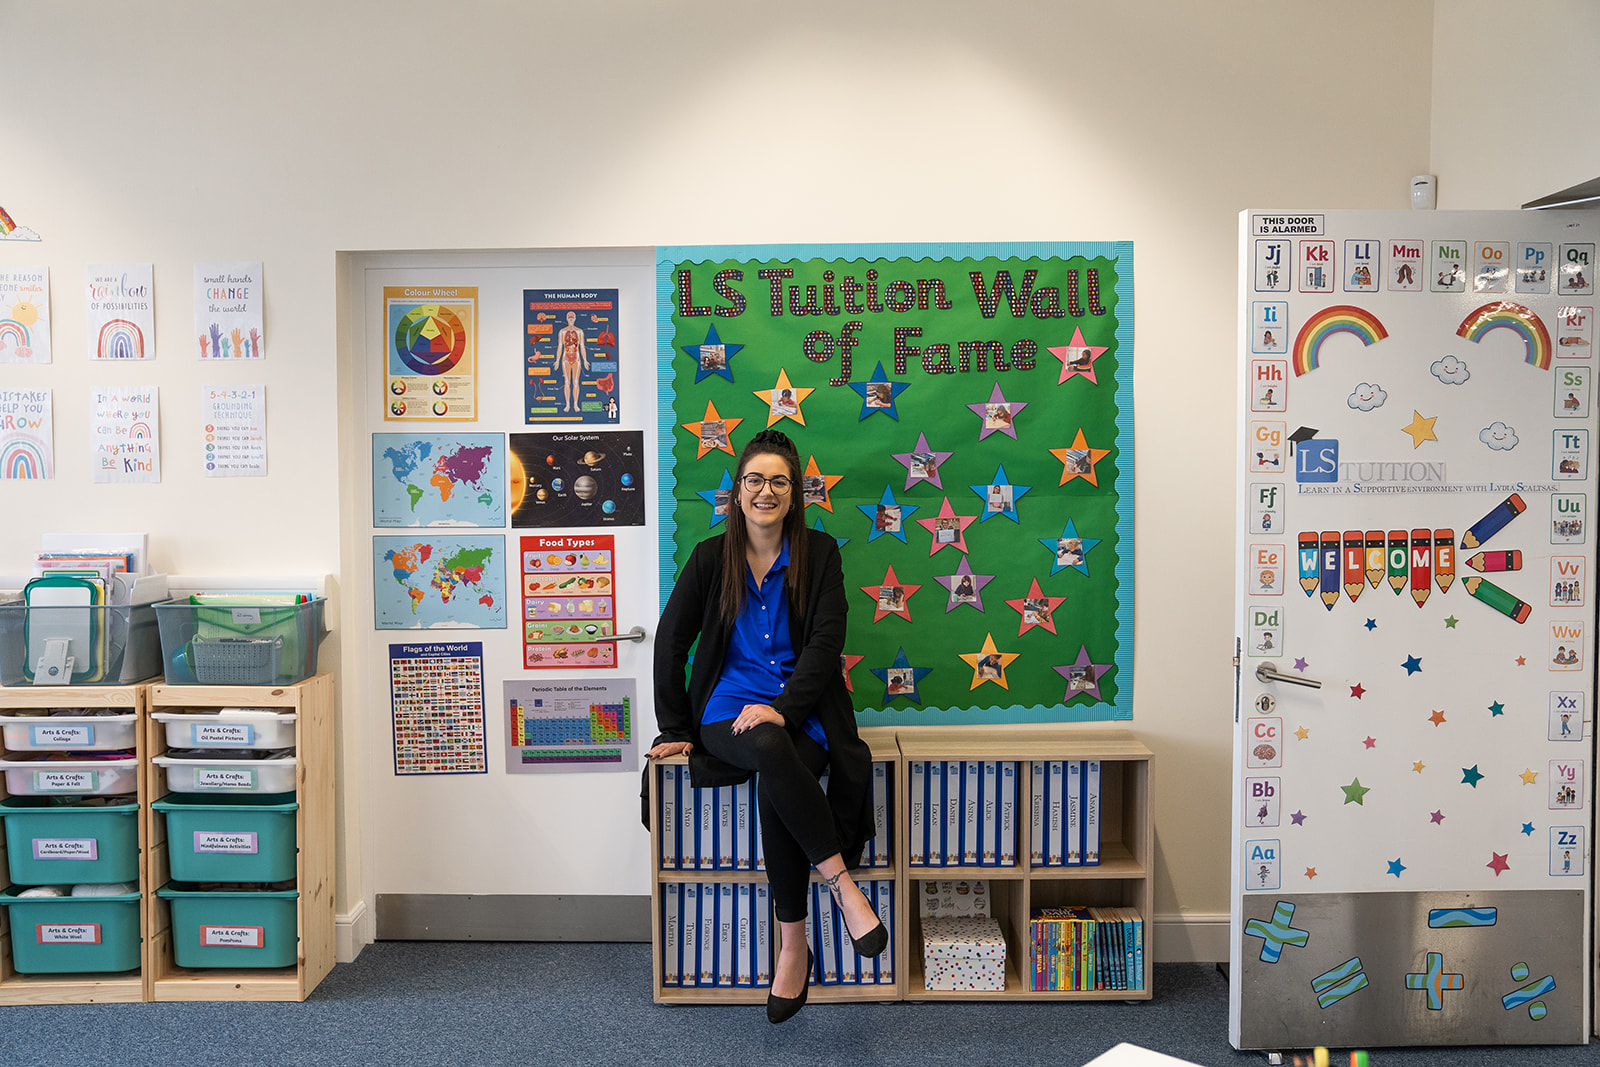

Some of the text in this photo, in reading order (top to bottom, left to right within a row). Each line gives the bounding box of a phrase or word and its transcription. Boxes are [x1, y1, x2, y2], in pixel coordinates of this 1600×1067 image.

[1272, 226, 1318, 234] ALARMED
[1265, 244, 1281, 266] Jj
[1306, 245, 1329, 262] Kk
[1393, 244, 1420, 258] Mm
[1438, 246, 1460, 259] Nn
[1525, 248, 1545, 264] Pp
[1566, 248, 1589, 266] Qq
[90, 272, 148, 300] rainbow
[204, 274, 252, 283] small hands
[206, 288, 248, 300] CHANGE
[678, 268, 1106, 319] LS Tuition Wall
[90, 302, 148, 310] OF POSSIBILITIES
[208, 304, 248, 312] the world
[1264, 306, 1278, 322] Ii
[803, 320, 1038, 386] of Fame
[1258, 364, 1282, 381] Hh
[1564, 372, 1582, 386] Ss
[210, 391, 256, 399] 5-4-3-2-1
[24, 404, 42, 414] YOU
[1256, 426, 1280, 446] Gg
[1562, 434, 1580, 449] Tt
[102, 457, 152, 473] Be Kind
[1299, 448, 1444, 481] LS TUITION
[1298, 484, 1330, 494] LEARN
[1354, 483, 1406, 493] SUPPORTIVE
[1490, 482, 1515, 492] LYDIA
[1260, 487, 1278, 508] Ff
[1558, 498, 1581, 513] Uu
[540, 538, 595, 548] Food Types
[1258, 550, 1278, 565] Ee
[1301, 548, 1450, 571] WELCOME
[1558, 561, 1580, 575] Vv
[1254, 610, 1279, 626] Dd
[1552, 626, 1582, 638] Ww
[1557, 696, 1576, 709] Xx
[1254, 723, 1276, 738] Cc
[1557, 765, 1576, 781] Yy
[1252, 781, 1275, 797] Bb
[1004, 802, 1012, 831] PATRICK
[1069, 795, 1078, 828] JASMINE
[1558, 832, 1577, 845] Zz
[1251, 846, 1275, 860] Aa
[822, 911, 830, 948] MATTHEW
